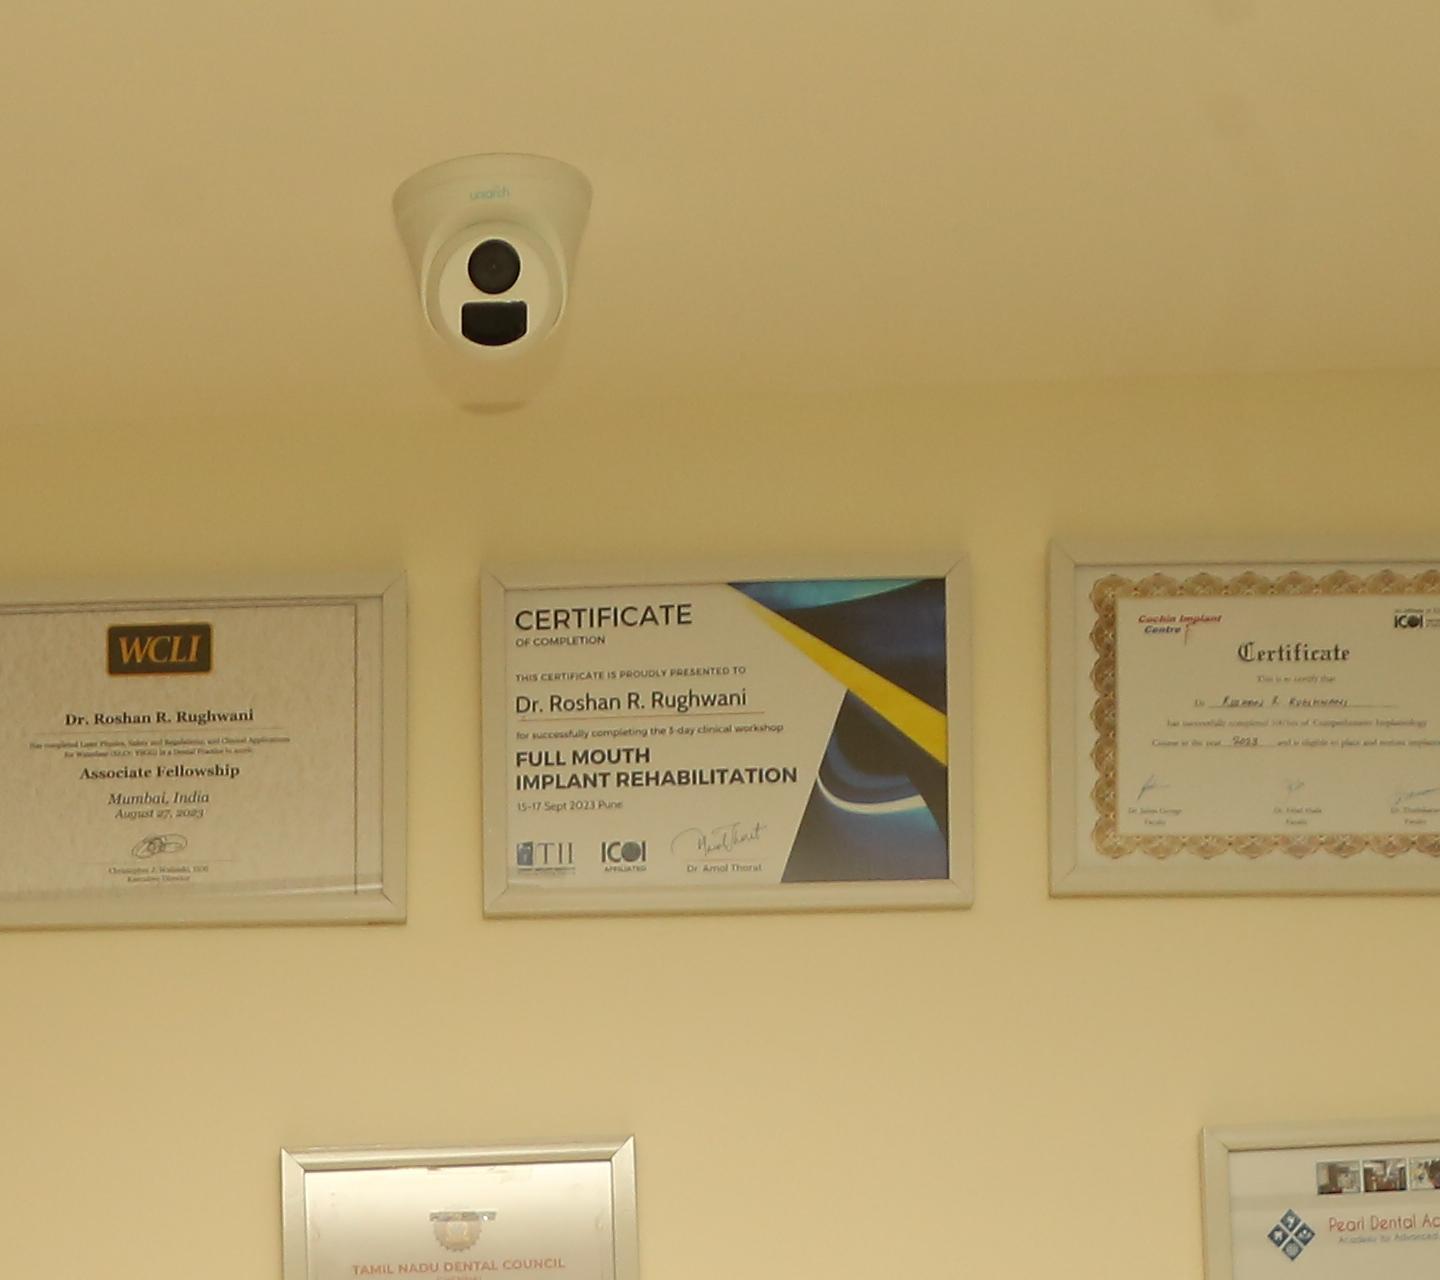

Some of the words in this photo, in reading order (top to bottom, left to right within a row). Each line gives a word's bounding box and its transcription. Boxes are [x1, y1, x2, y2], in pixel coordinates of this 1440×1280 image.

[515, 604, 692, 630] CERTIFICATE
[118, 634, 202, 665] WCLI
[516, 638, 530, 647] OF
[533, 636, 605, 646] COMPLETION
[1238, 642, 1350, 662] Certificate
[516, 673, 537, 682] THIS
[541, 671, 603, 681] CERTIFICATE
[607, 671, 616, 679] IS
[620, 669, 667, 679] PROUDLY
[671, 667, 730, 677] PRESENTED
[733, 666, 746, 674] TO
[516, 696, 543, 713] Dr.
[549, 693, 621, 712] Roshan
[627, 692, 645, 709] R.
[651, 688, 746, 713] Rughwani
[65, 712, 89, 726] Dr.
[94, 711, 151, 725] Roshan
[156, 710, 171, 723] R.
[176, 709, 254, 726] Rughwani
[516, 751, 566, 767] FULL
[572, 748, 649, 765] MOUTH
[79, 765, 152, 779] Associate
[156, 764, 240, 780] Fellowship
[516, 773, 610, 790] IMPLANT
[616, 767, 797, 787] REHABILITATION
[108, 792, 168, 806] Mumbai,
[174, 791, 209, 804] India
[114, 808, 153, 820] August
[1329, 1216, 1365, 1232] Pearl
[1371, 1214, 1416, 1229] Dental
[352, 1263, 394, 1276] TAMIL
[398, 1261, 439, 1274] NADU
[444, 1260, 498, 1272] DENTAL
[503, 1258, 565, 1270] COUNCIL
